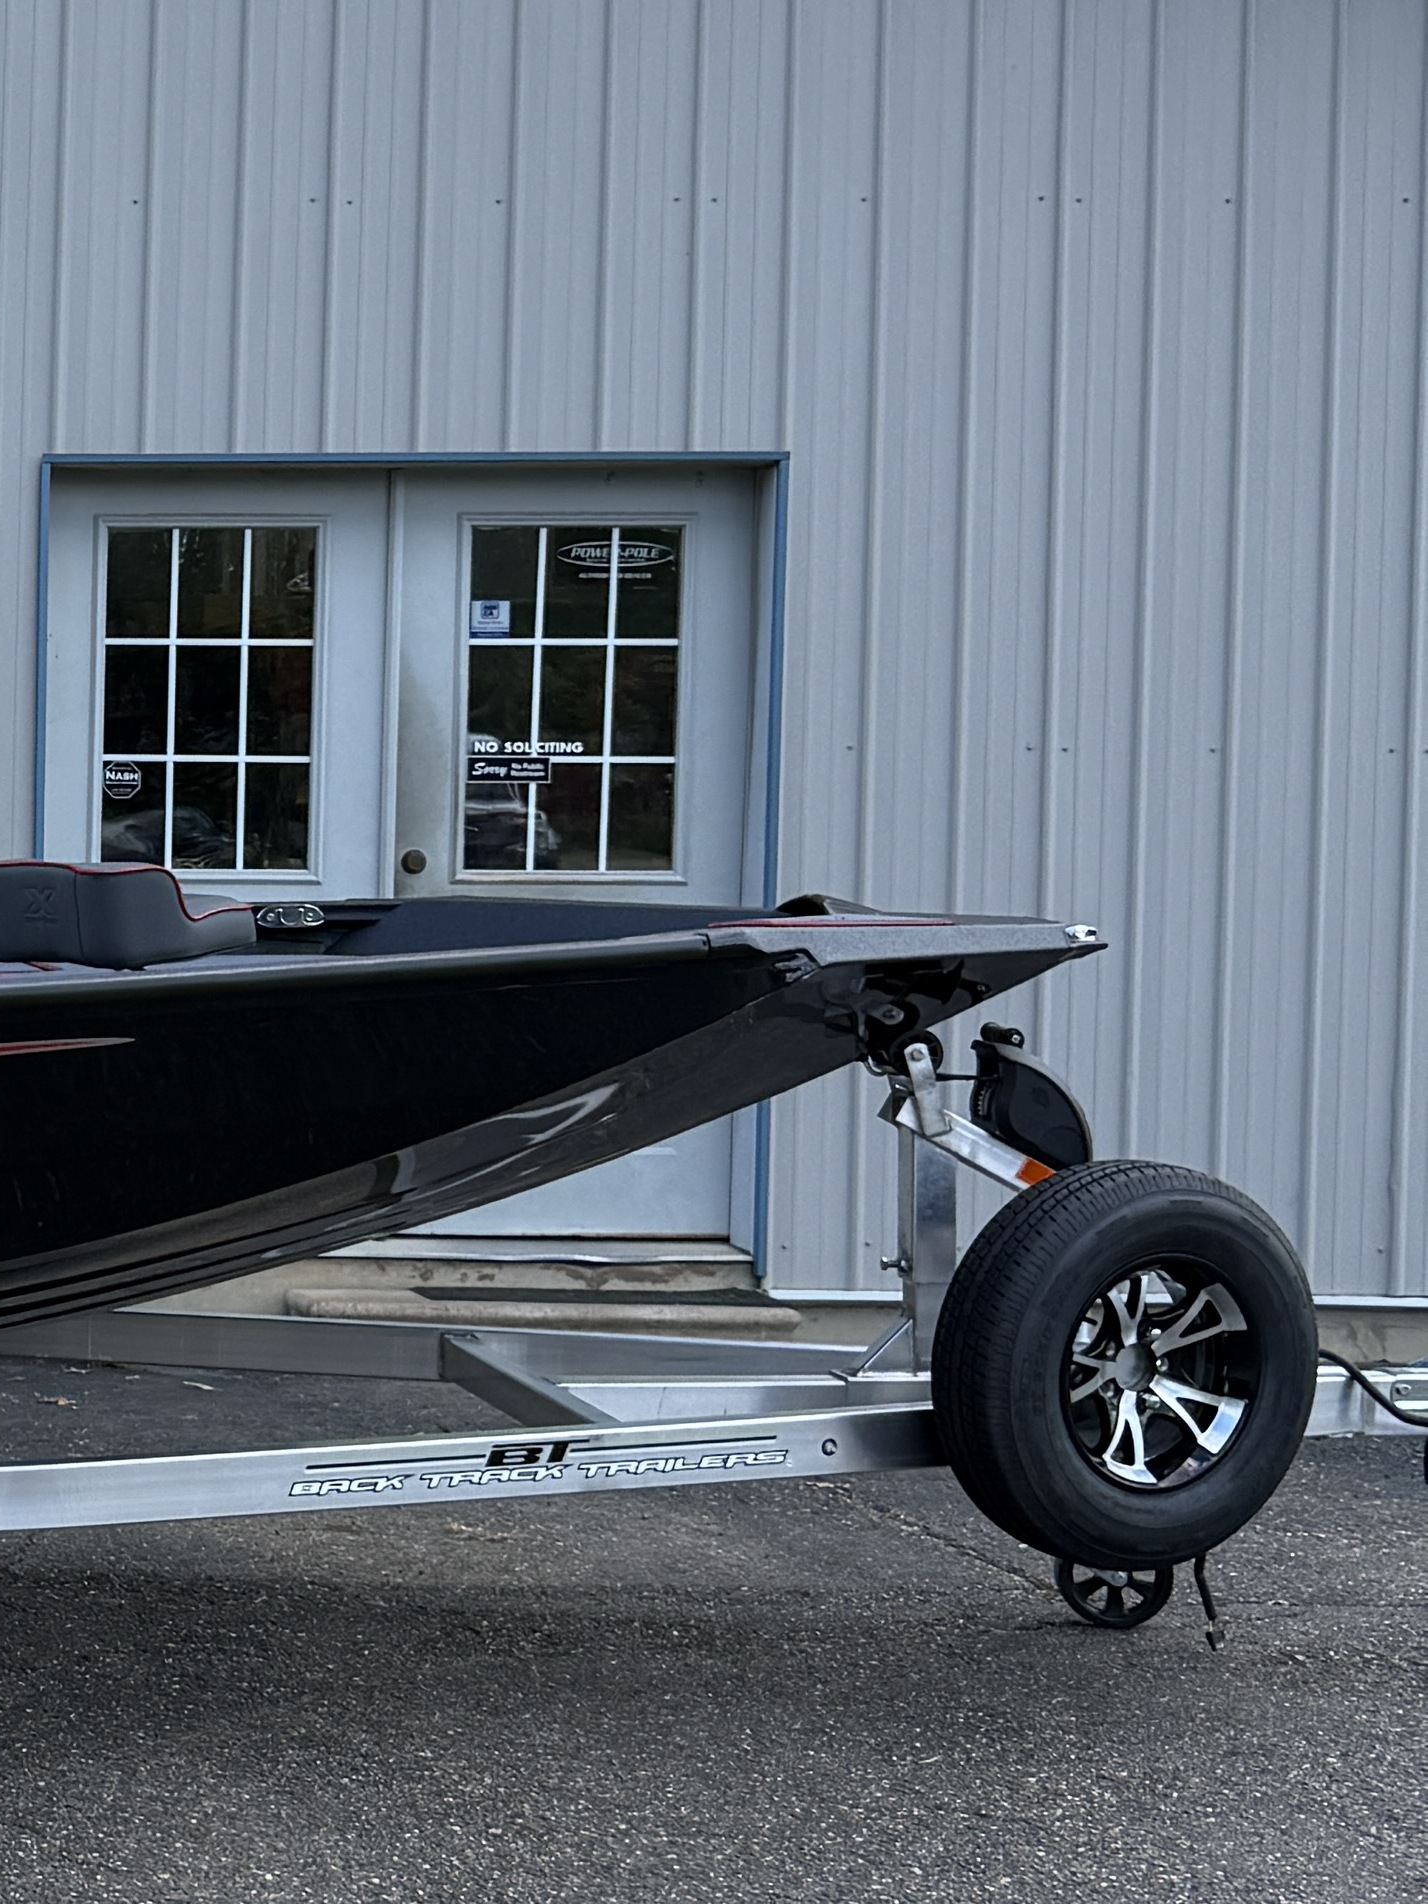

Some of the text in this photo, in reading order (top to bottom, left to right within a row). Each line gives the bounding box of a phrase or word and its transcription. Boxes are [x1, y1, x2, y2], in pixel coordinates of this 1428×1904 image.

[570, 547, 661, 559] POWE-POLE
[474, 741, 584, 753] NO SOLCITING
[106, 771, 139, 780] NASH
[485, 1439, 590, 1467] BT
[289, 1449, 789, 1497] BACK TRACK TRAILERS
